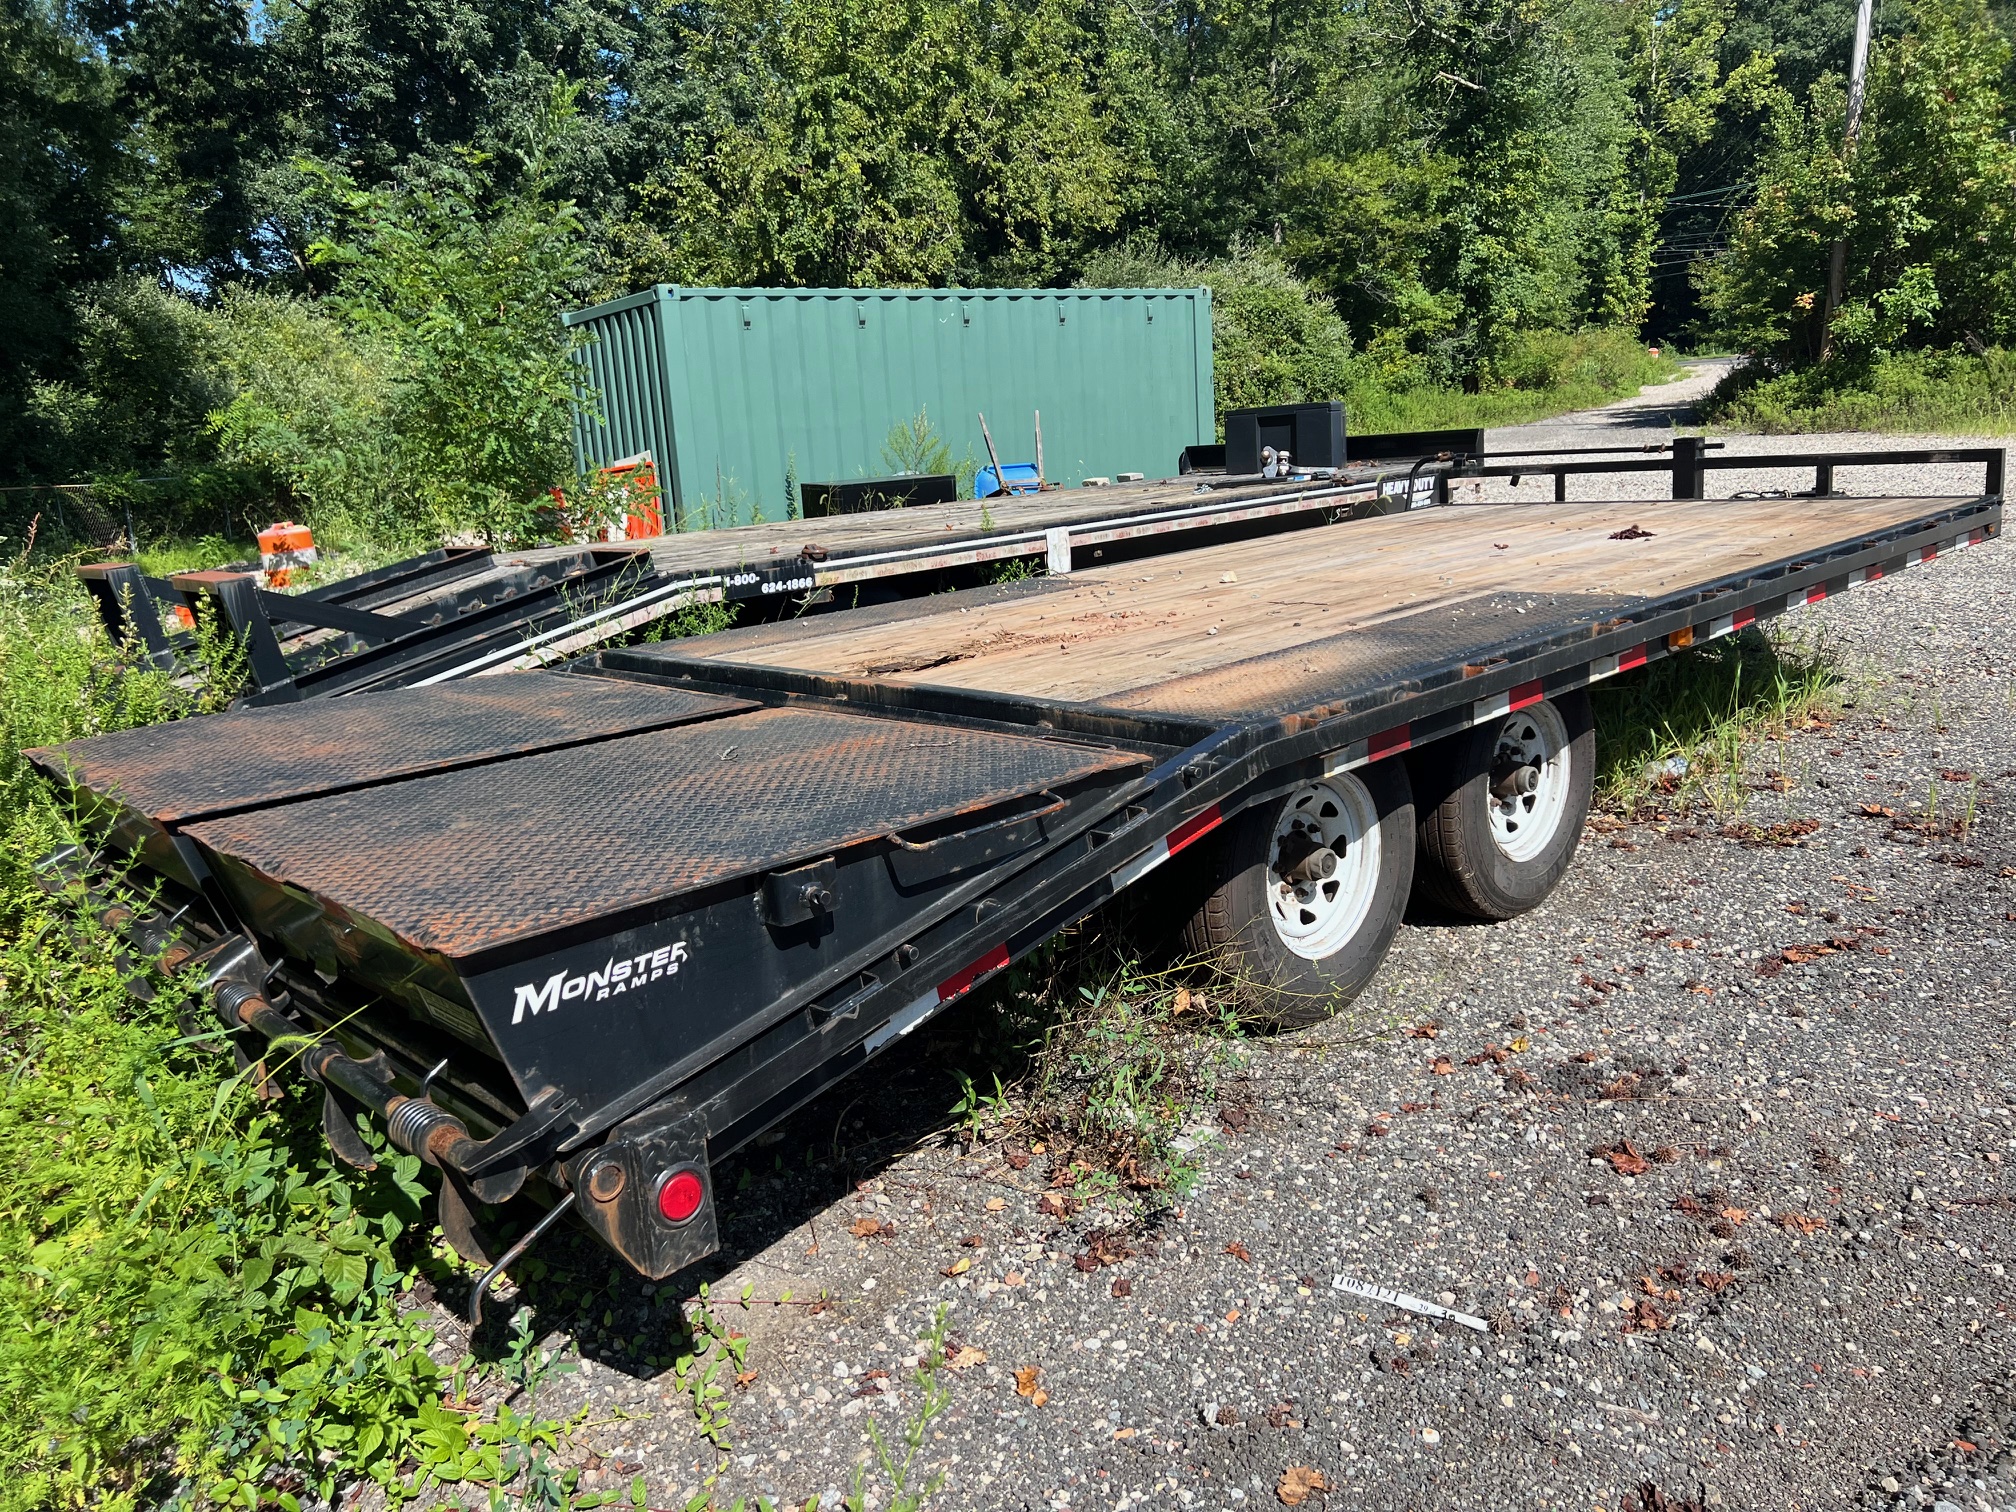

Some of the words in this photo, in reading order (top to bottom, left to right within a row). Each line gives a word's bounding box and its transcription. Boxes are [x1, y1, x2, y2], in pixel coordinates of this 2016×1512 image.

[1382, 479, 1410, 496] HEAVY
[1412, 475, 1436, 492] DUTY
[761, 576, 813, 594] 624-1866
[511, 940, 689, 1025] MONSTER
[595, 962, 680, 1002] RAMPS
